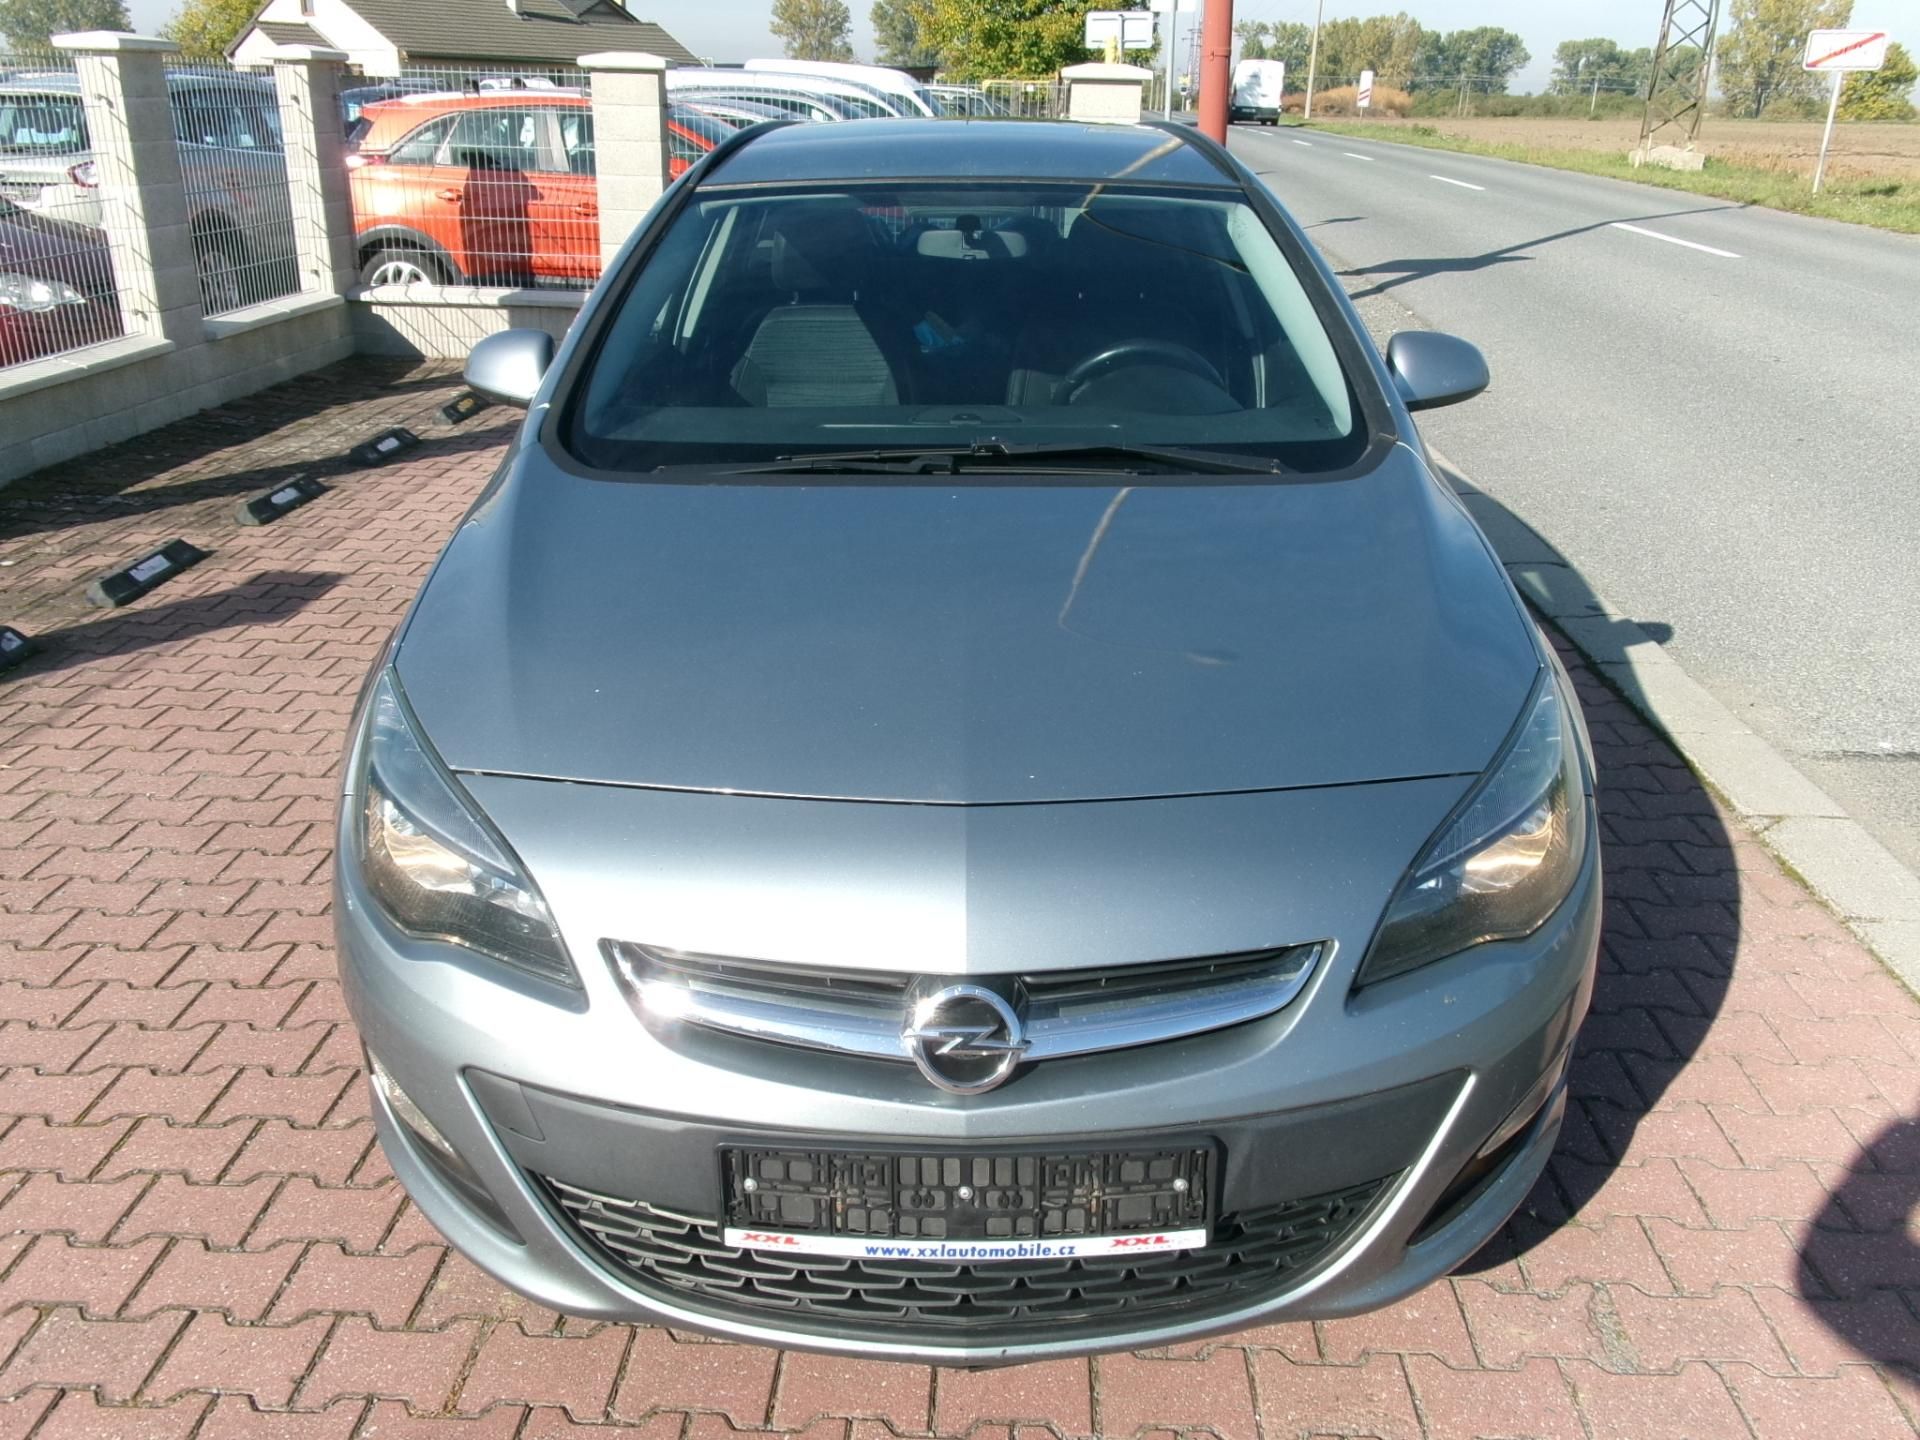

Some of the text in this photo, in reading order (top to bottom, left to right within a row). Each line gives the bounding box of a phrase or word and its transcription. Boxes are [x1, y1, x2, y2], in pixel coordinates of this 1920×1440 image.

[743, 1233, 800, 1246] XXL
[1111, 1235, 1170, 1247] XXL
[866, 1244, 1076, 1258] www.xxlautomobile.cz
